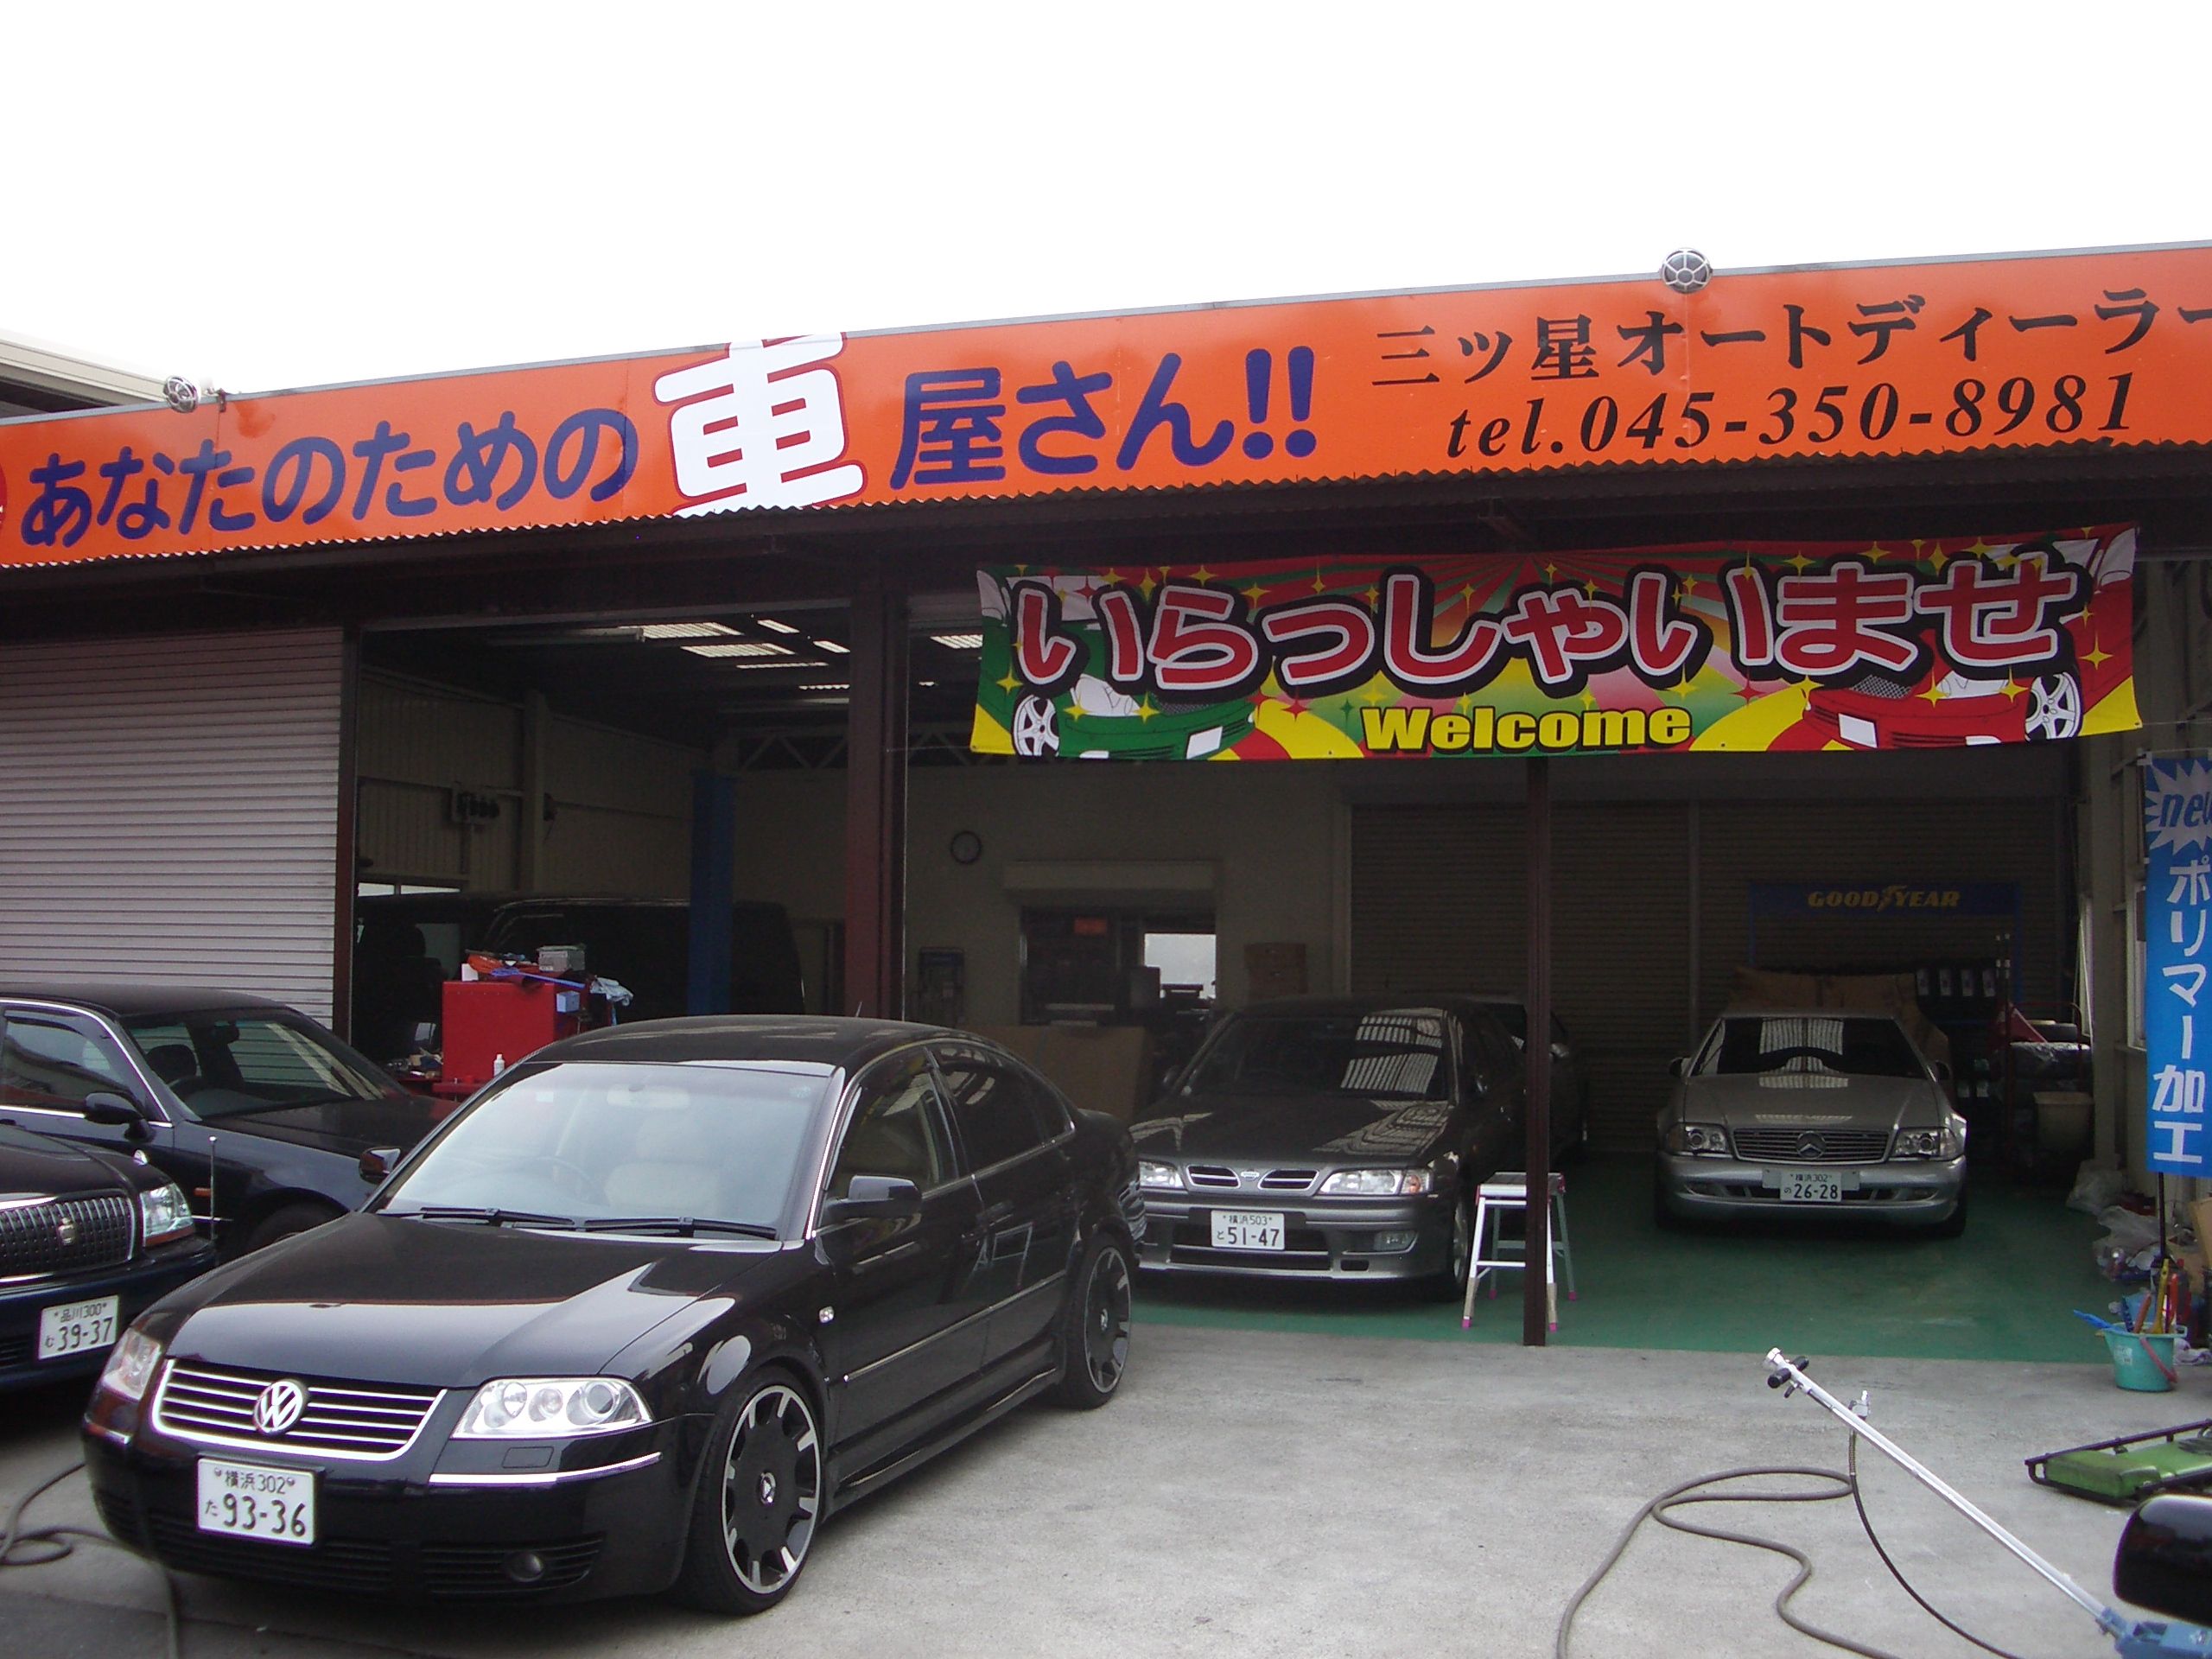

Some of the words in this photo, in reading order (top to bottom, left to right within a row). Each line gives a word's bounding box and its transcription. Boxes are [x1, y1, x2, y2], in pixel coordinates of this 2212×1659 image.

[1446, 371, 2135, 459] tel.045-350-8981
[1013, 552, 2080, 691] いらっしゃいませ
[1362, 706, 1692, 753] Welcome
[2159, 791, 2212, 828] ne
[2152, 855, 2211, 1164] ポリマー加工
[1794, 1183, 1838, 1199] 26-28
[1228, 1226, 1280, 1246] 51-47
[56, 1316, 113, 1351] 39-37
[225, 1470, 286, 1495] 横浜302
[223, 1492, 306, 1536] 93-36
